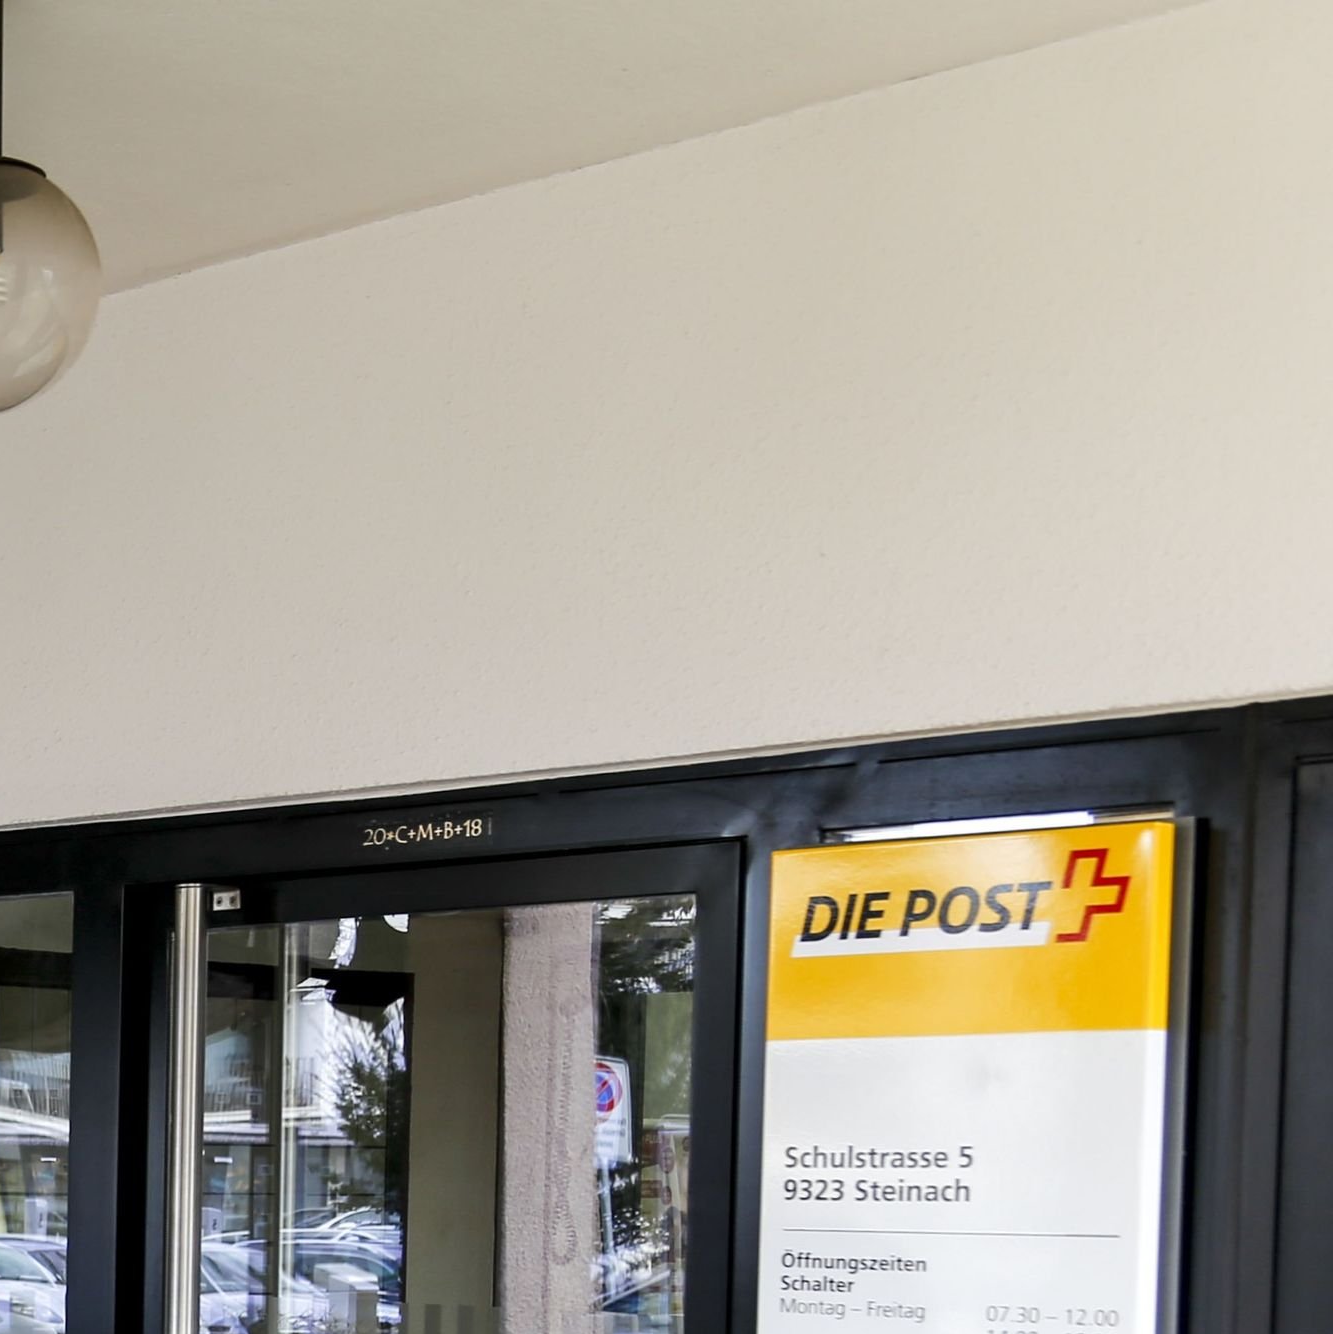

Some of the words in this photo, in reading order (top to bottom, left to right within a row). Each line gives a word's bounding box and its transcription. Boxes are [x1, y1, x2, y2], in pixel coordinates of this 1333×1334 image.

[799, 891, 891, 943] DIE
[899, 881, 1053, 937] POST
[784, 1145, 949, 1169] Schulstrasse
[958, 1146, 974, 1169] 5
[783, 1178, 845, 1202] 9323
[854, 1178, 972, 1203] Steinach
[781, 1249, 928, 1275] Öffnungszeiten
[780, 1275, 855, 1294] Schalter
[780, 1298, 846, 1319] Montag
[867, 1300, 926, 1322] Freitag
[986, 1304, 1040, 1324] 07.30
[1065, 1308, 1120, 1328] 12.00
